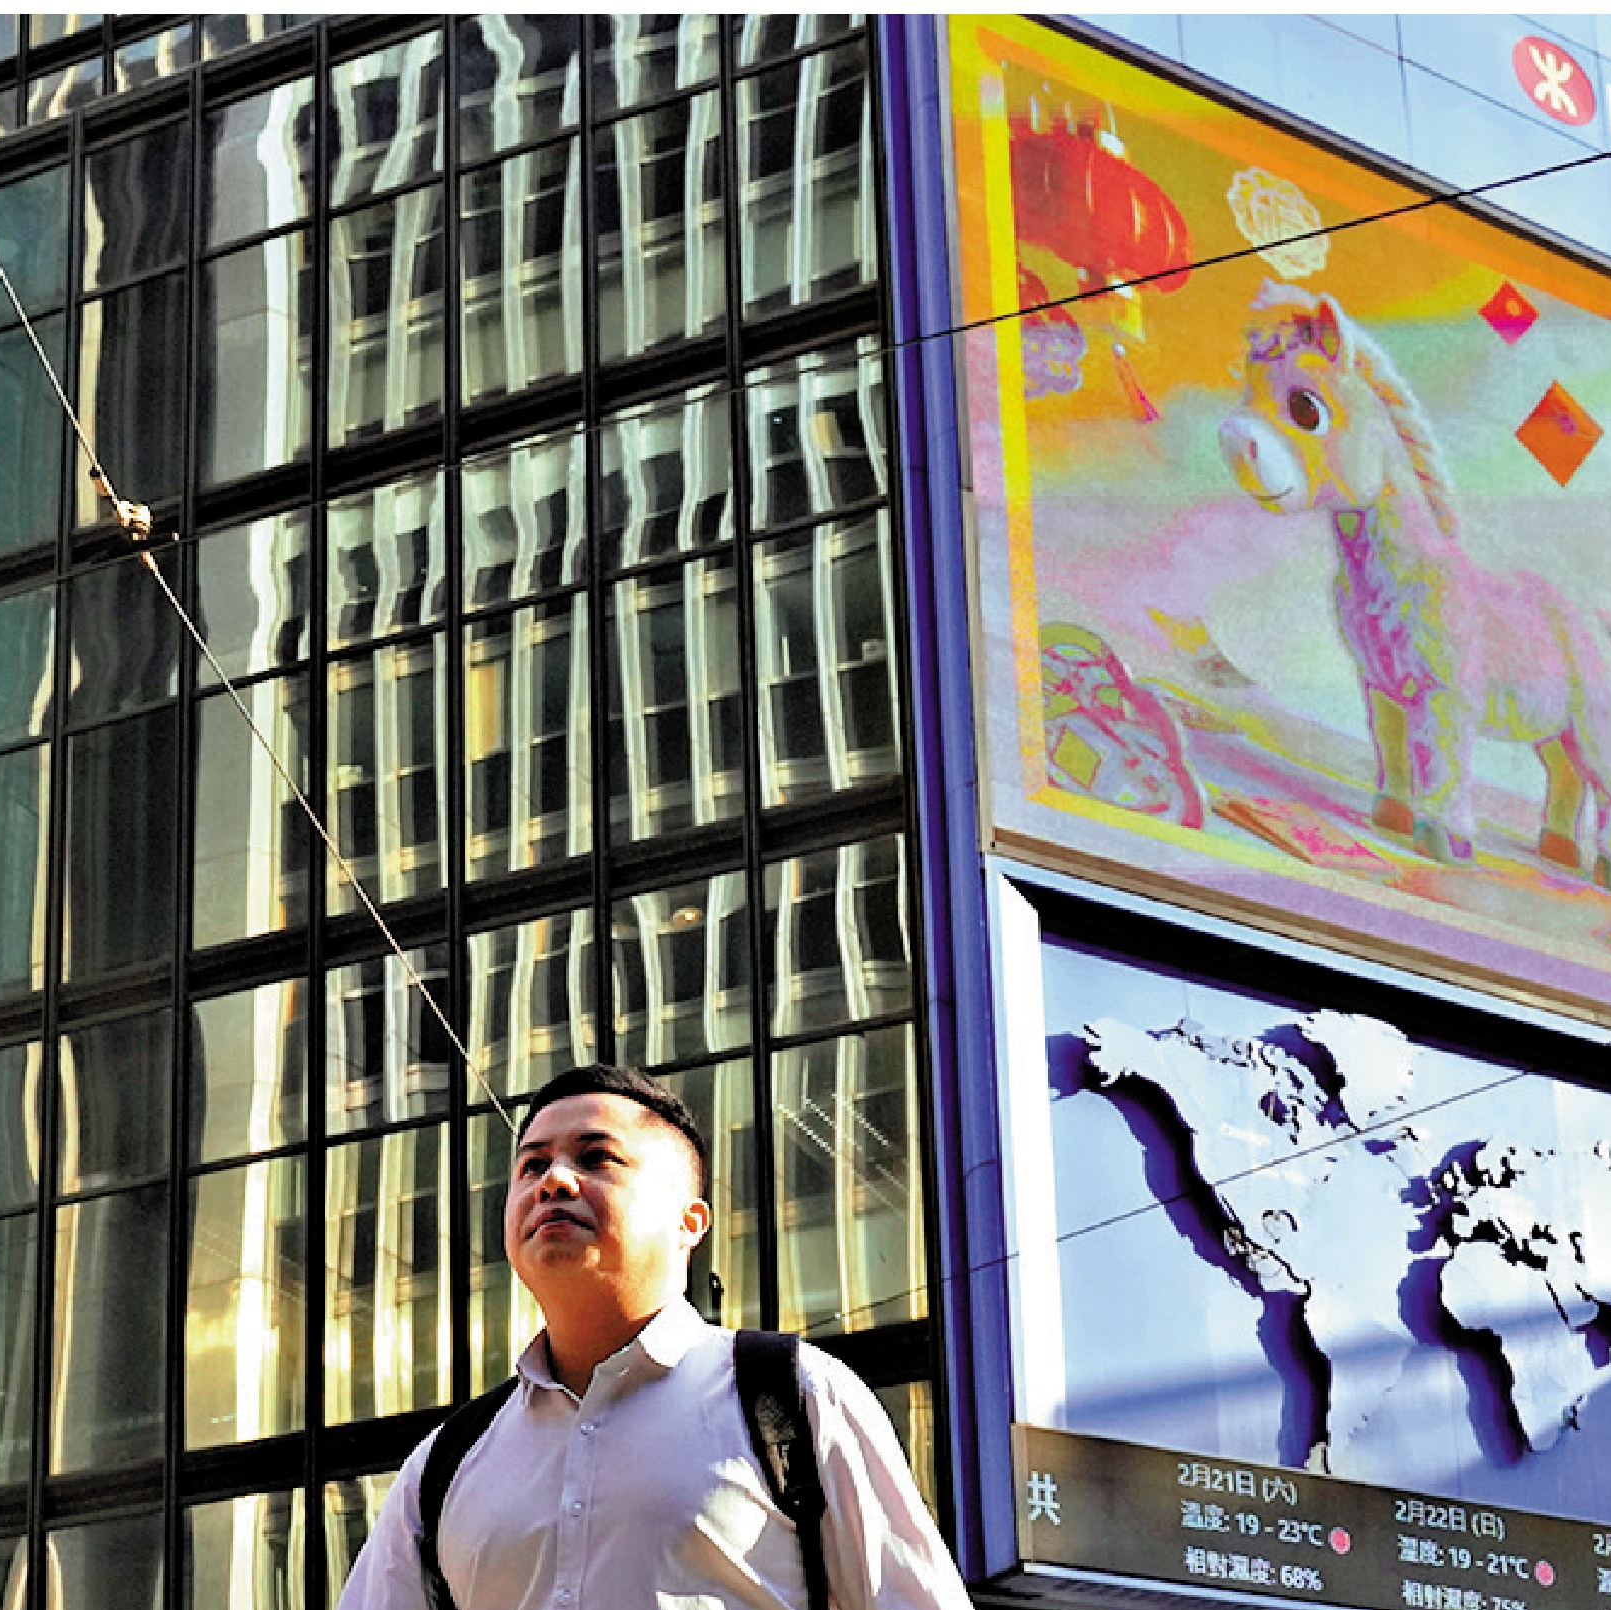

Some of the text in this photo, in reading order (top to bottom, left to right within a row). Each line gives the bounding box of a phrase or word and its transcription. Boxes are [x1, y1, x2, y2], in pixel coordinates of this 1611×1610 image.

[1178, 1463, 1256, 1496] 2月21日
[1028, 1471, 1060, 1525] 共
[1236, 1513, 1258, 1534] 19
[1396, 1500, 1466, 1532] 2月22日
[1449, 1549, 1471, 1568] 19
[1281, 1564, 1323, 1591] 68%
